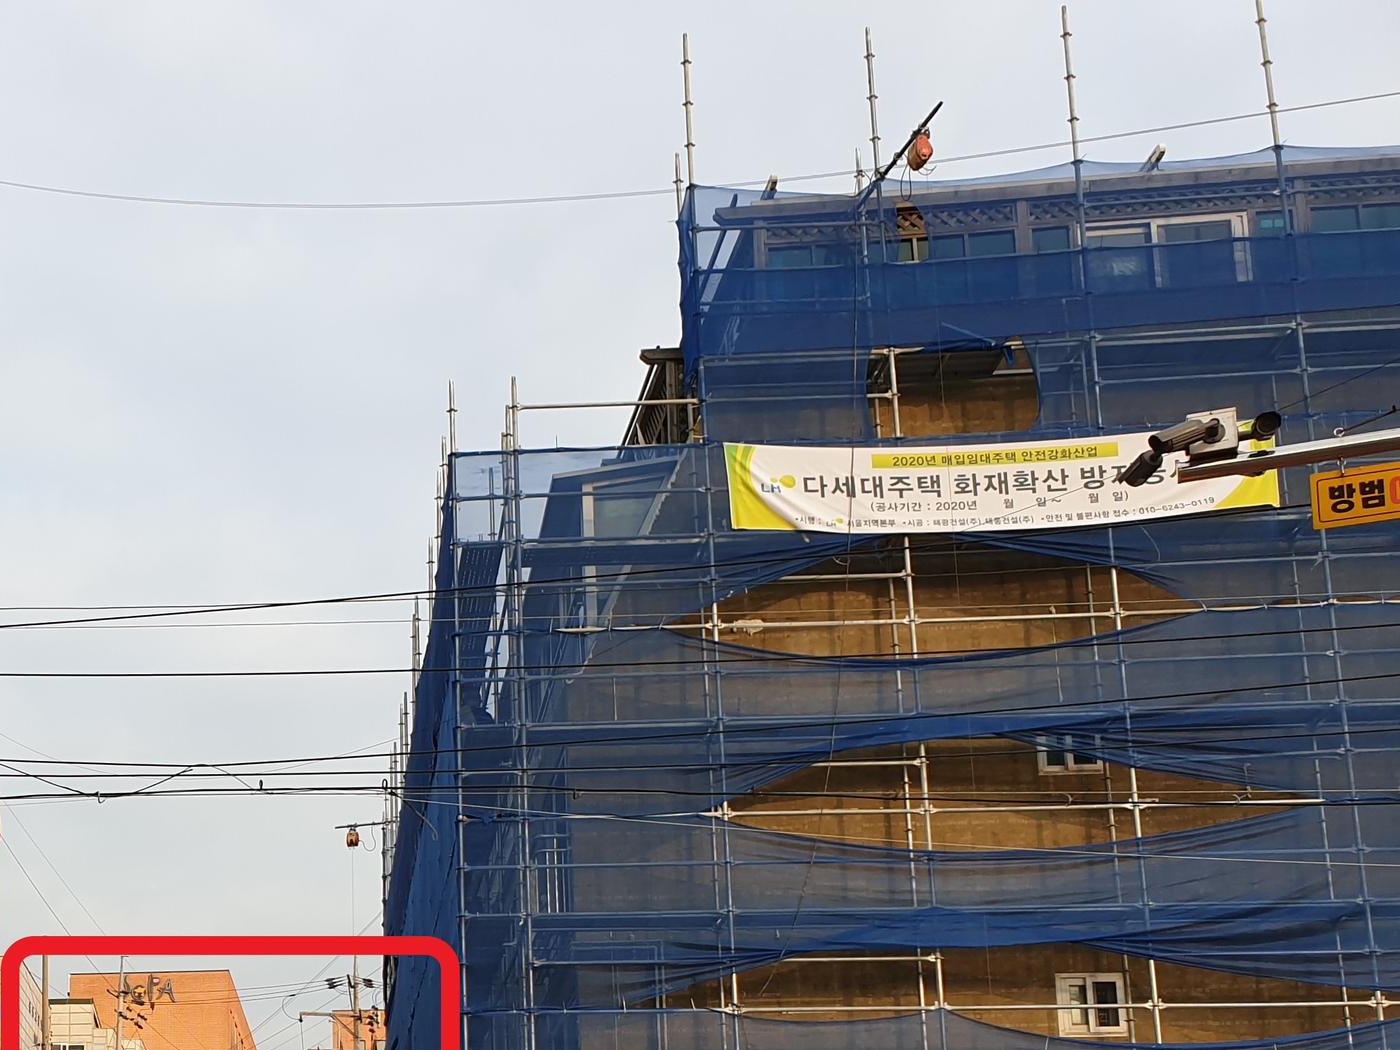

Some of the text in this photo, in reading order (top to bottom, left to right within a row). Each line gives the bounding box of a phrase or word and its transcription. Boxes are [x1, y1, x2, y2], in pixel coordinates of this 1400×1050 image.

[892, 445, 1098, 467] 2020년 매입임대주택 안전강화산업
[803, 474, 942, 499] 다세대주택
[954, 468, 1069, 496] 화재확산
[1328, 478, 1386, 513] 방범
[870, 501, 922, 513] (공사기간
[936, 499, 977, 511] 2020년
[1003, 497, 1014, 509] 월
[1088, 492, 1099, 503] 월
[1112, 491, 1129, 502] 일)
